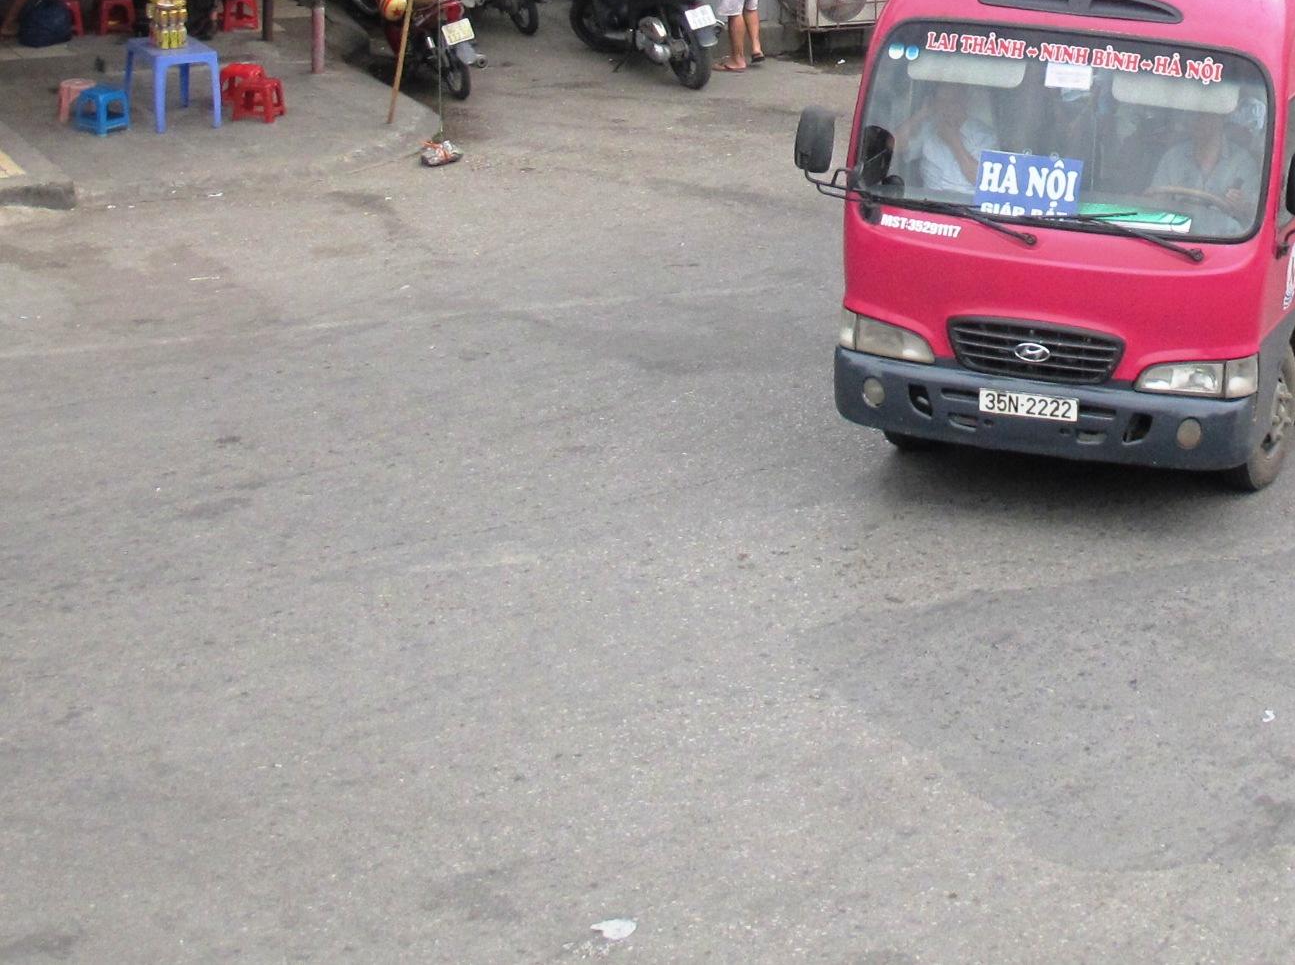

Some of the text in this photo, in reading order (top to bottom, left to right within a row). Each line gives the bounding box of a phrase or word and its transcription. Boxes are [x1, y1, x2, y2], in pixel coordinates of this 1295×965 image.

[926, 32, 1224, 85] LAI THÀNH NINH BÌNH HÀ NỘI
[978, 154, 1079, 208] HÀ NỘI
